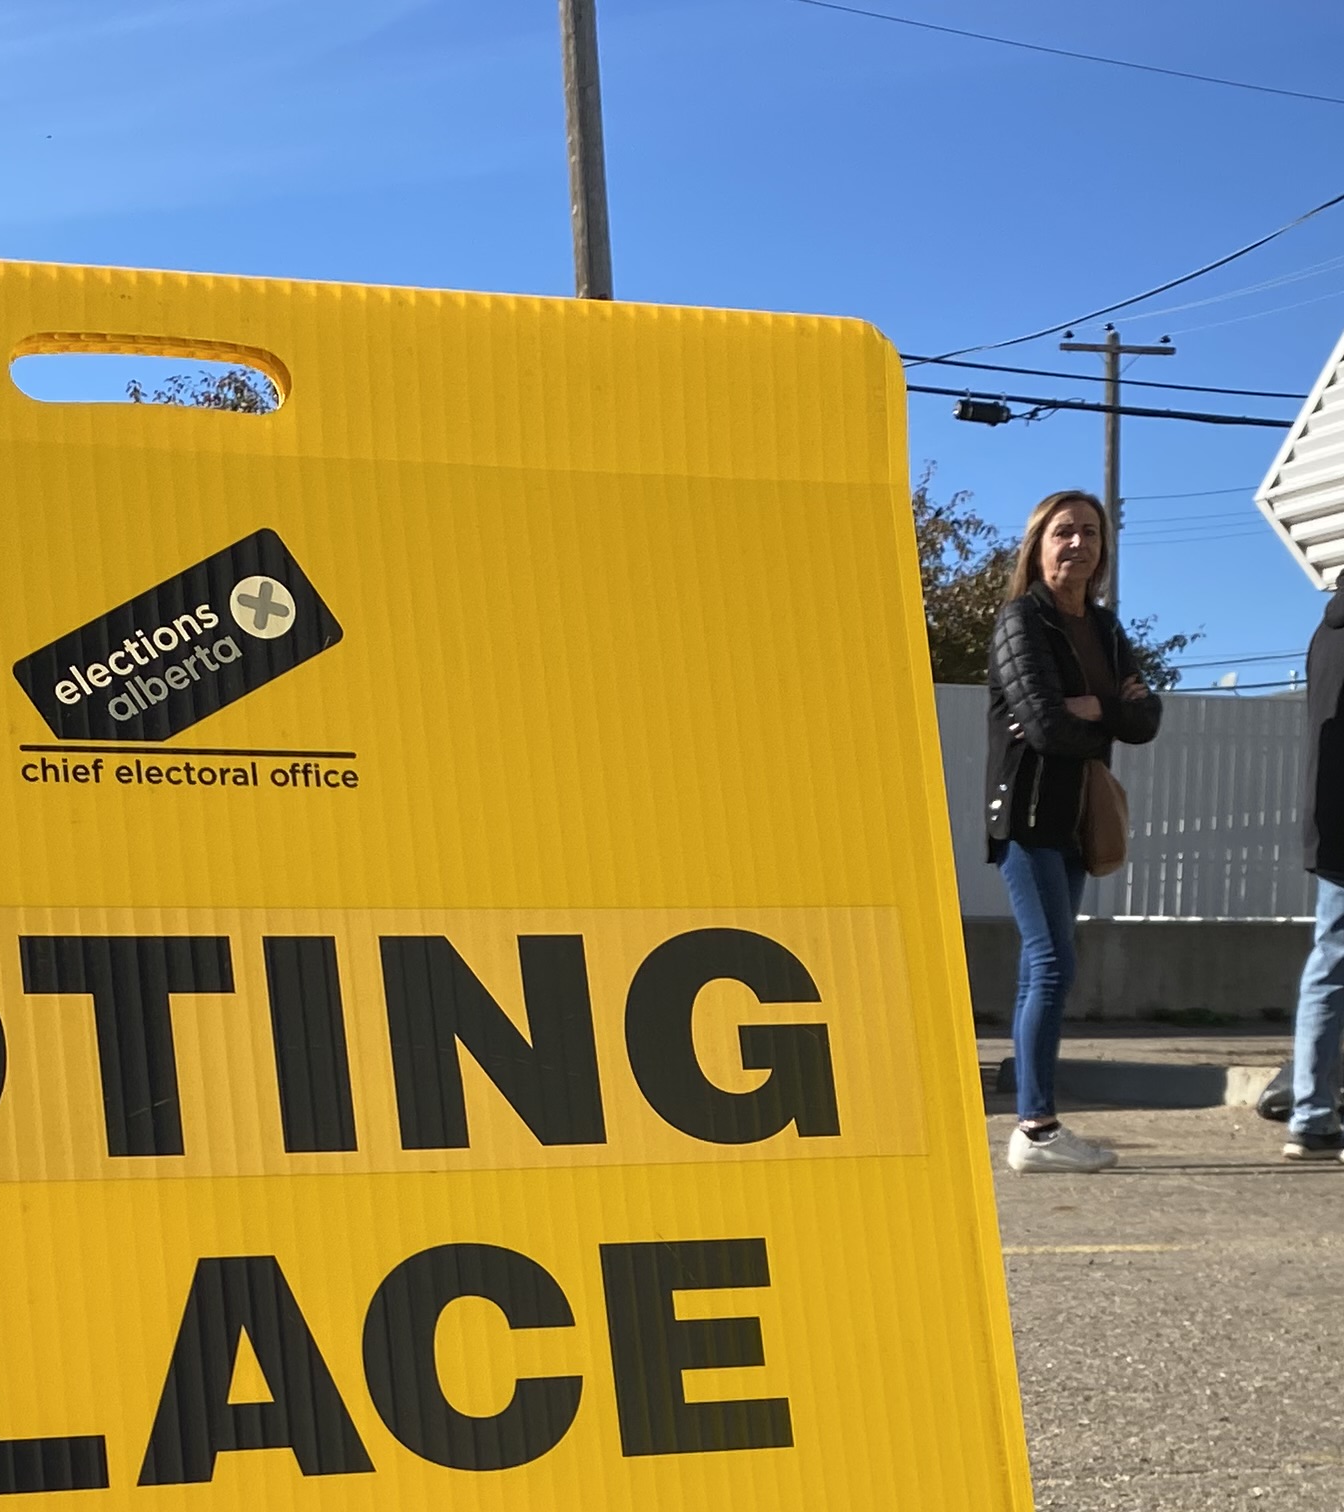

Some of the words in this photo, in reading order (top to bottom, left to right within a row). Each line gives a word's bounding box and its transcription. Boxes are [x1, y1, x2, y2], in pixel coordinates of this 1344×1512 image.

[54, 601, 220, 705] elections
[107, 634, 244, 722] alberta
[20, 757, 104, 784] chief
[114, 758, 259, 787] electoral
[269, 761, 359, 789] office
